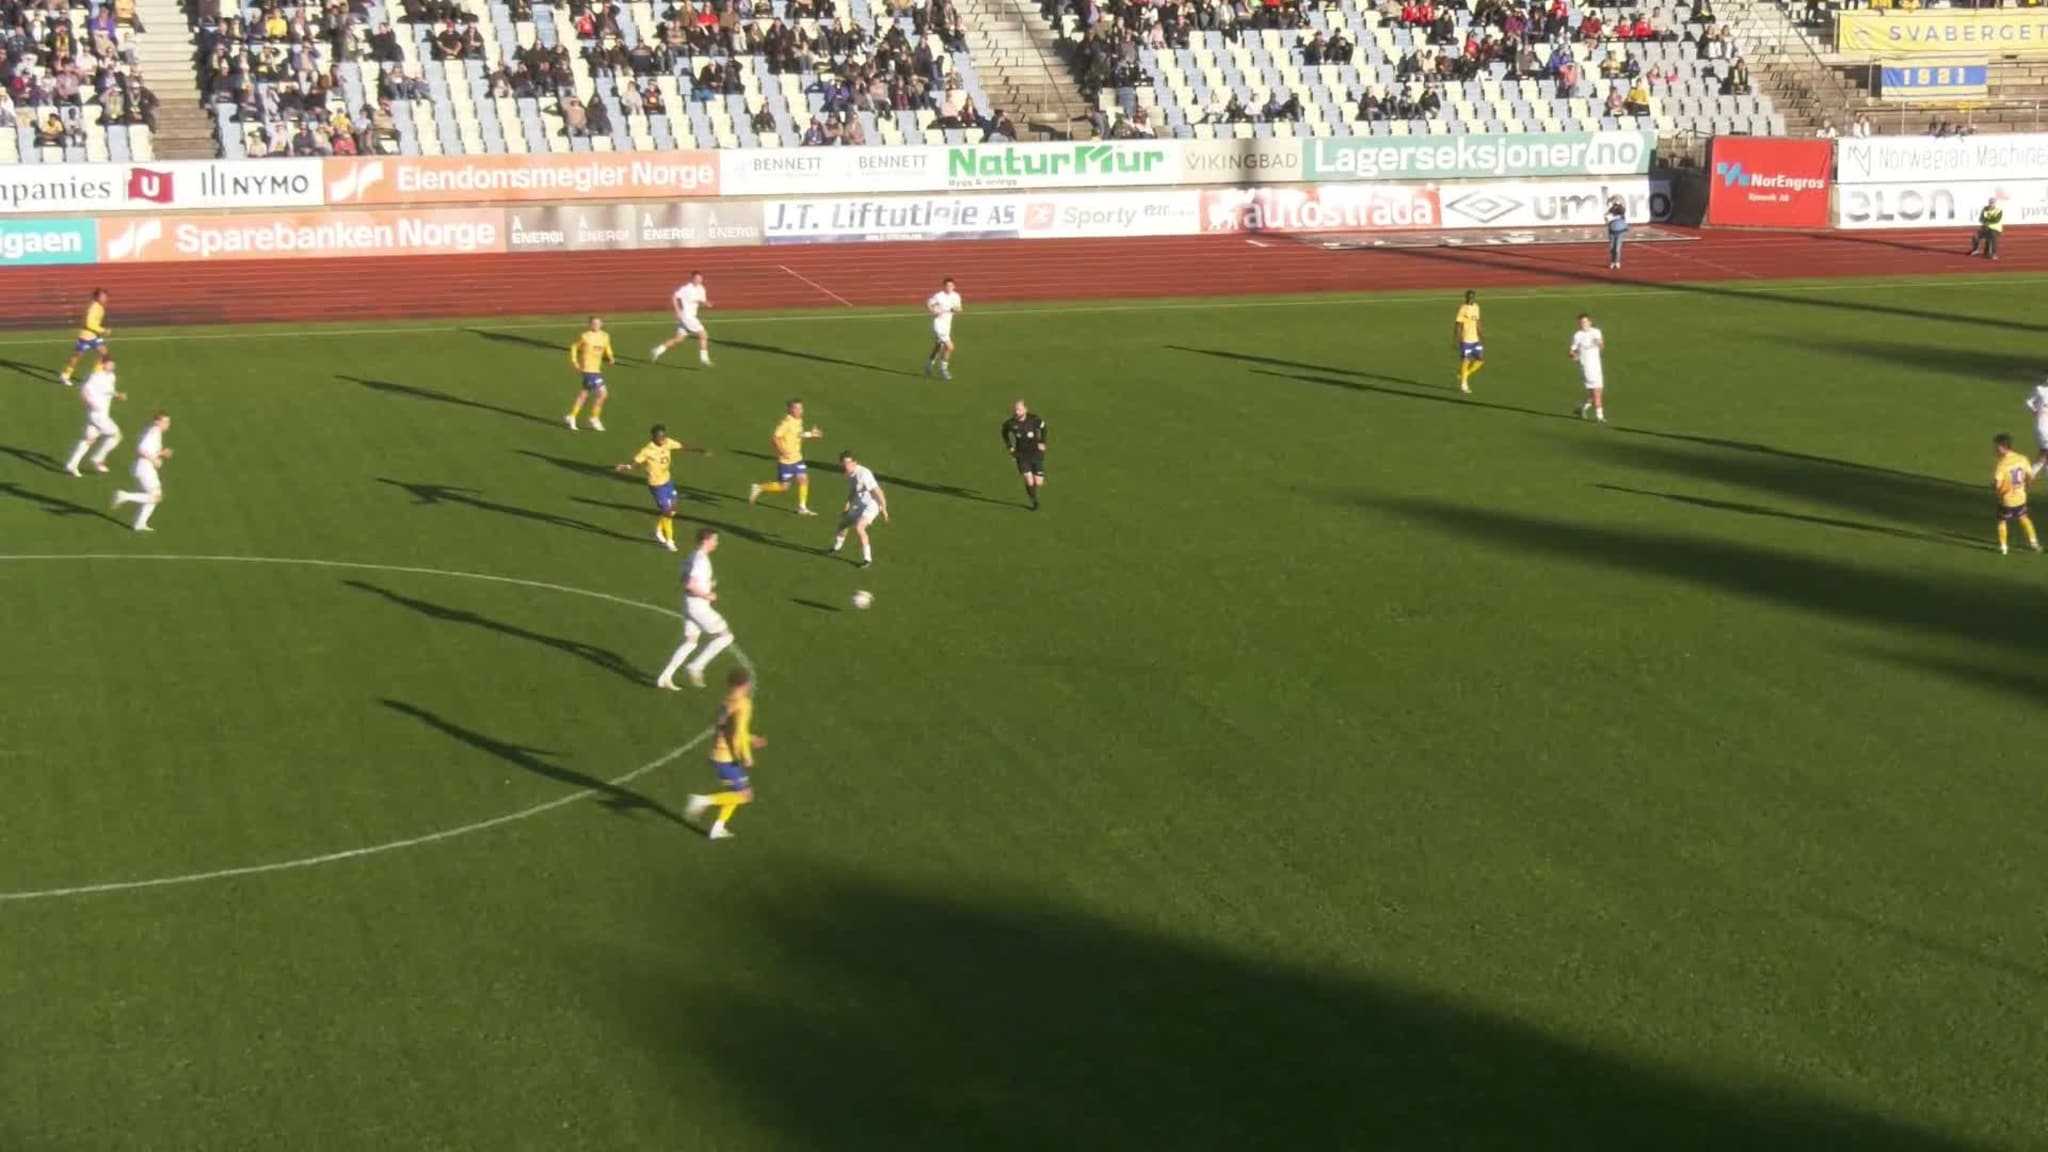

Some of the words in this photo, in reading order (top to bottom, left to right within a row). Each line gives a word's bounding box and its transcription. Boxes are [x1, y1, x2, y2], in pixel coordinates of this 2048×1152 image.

[1889, 23, 2048, 42] SVABERGET
[753, 156, 823, 172] BENNETT
[858, 154, 928, 169] BENNETT
[1185, 151, 1298, 171] VIKINGBAD
[1879, 146, 1969, 170] Norwegian
[233, 174, 309, 196] NYMO
[397, 163, 629, 192] Eiendomsmegler
[631, 161, 714, 189] Norge
[1751, 173, 1824, 192] NorEngros
[768, 203, 819, 231] J.T.
[987, 204, 1015, 225] AS
[175, 220, 393, 256] Sparebanken
[399, 217, 496, 250] Norge
[511, 230, 564, 245] ENERGI
[579, 230, 629, 243] ENERGI
[643, 228, 695, 241] ENERGI
[707, 226, 759, 239] ENERGI
